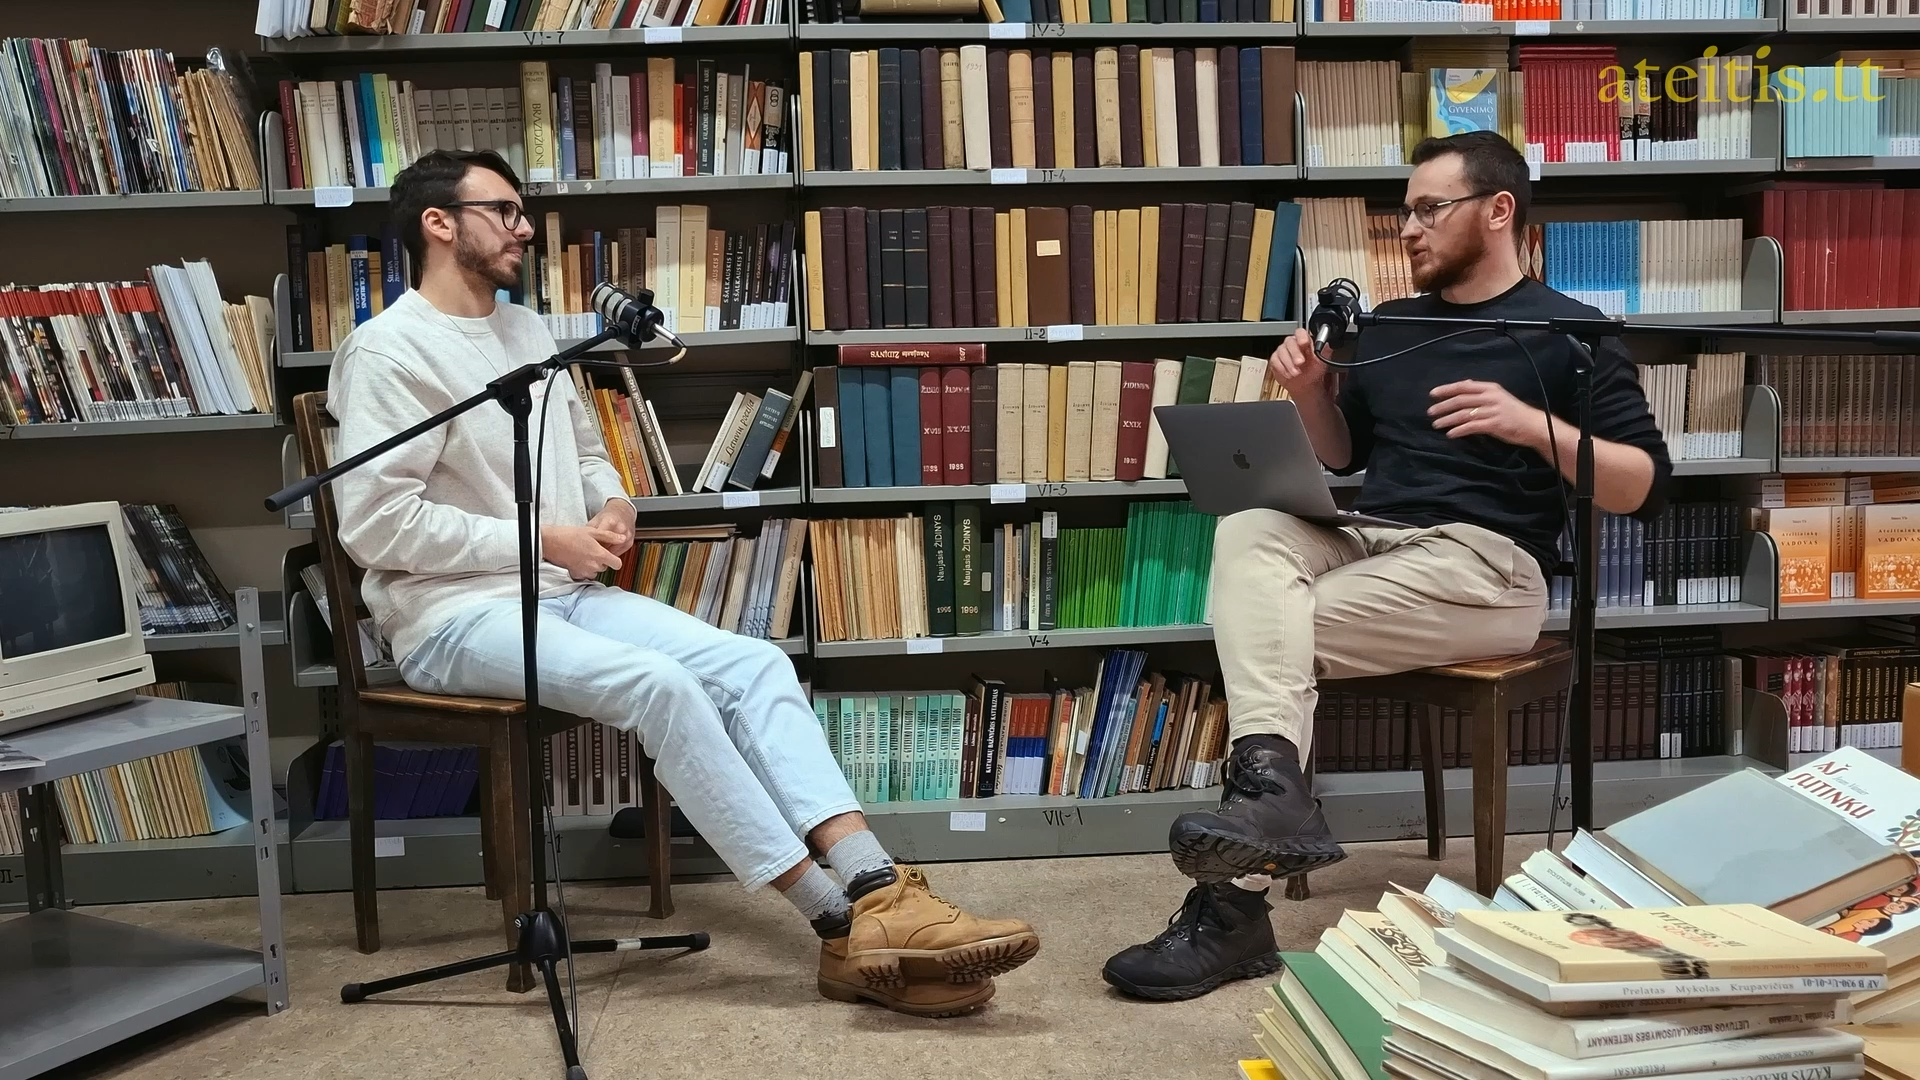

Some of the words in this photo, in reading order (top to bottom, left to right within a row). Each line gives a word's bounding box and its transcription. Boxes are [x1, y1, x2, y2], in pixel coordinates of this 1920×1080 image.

[1449, 105, 1494, 113] GYVENIMO
[531, 103, 545, 168] BRAZDŽIONIS
[738, 399, 758, 426] poezija
[934, 514, 943, 548] ŽIDINYS
[962, 519, 971, 552] ŽIDINYS
[935, 549, 946, 582] Naujasis
[963, 554, 973, 586] Naujasis
[1812, 761, 1852, 776] AŠ
[1787, 772, 1876, 819] SUTINKU
[1622, 986, 1666, 996] Prelatas
[1675, 984, 1720, 995] Mykolas
[1730, 980, 1794, 992] Krupavičius
[1858, 979, 1865, 989] B
[1636, 1023, 1715, 1042] NEPRIKLAUSOMYBĖS
[1716, 1020, 1750, 1034] LIETUVOS
[1587, 1033, 1634, 1047] NETENKANT
[1791, 1065, 1832, 1080] KAZYS
